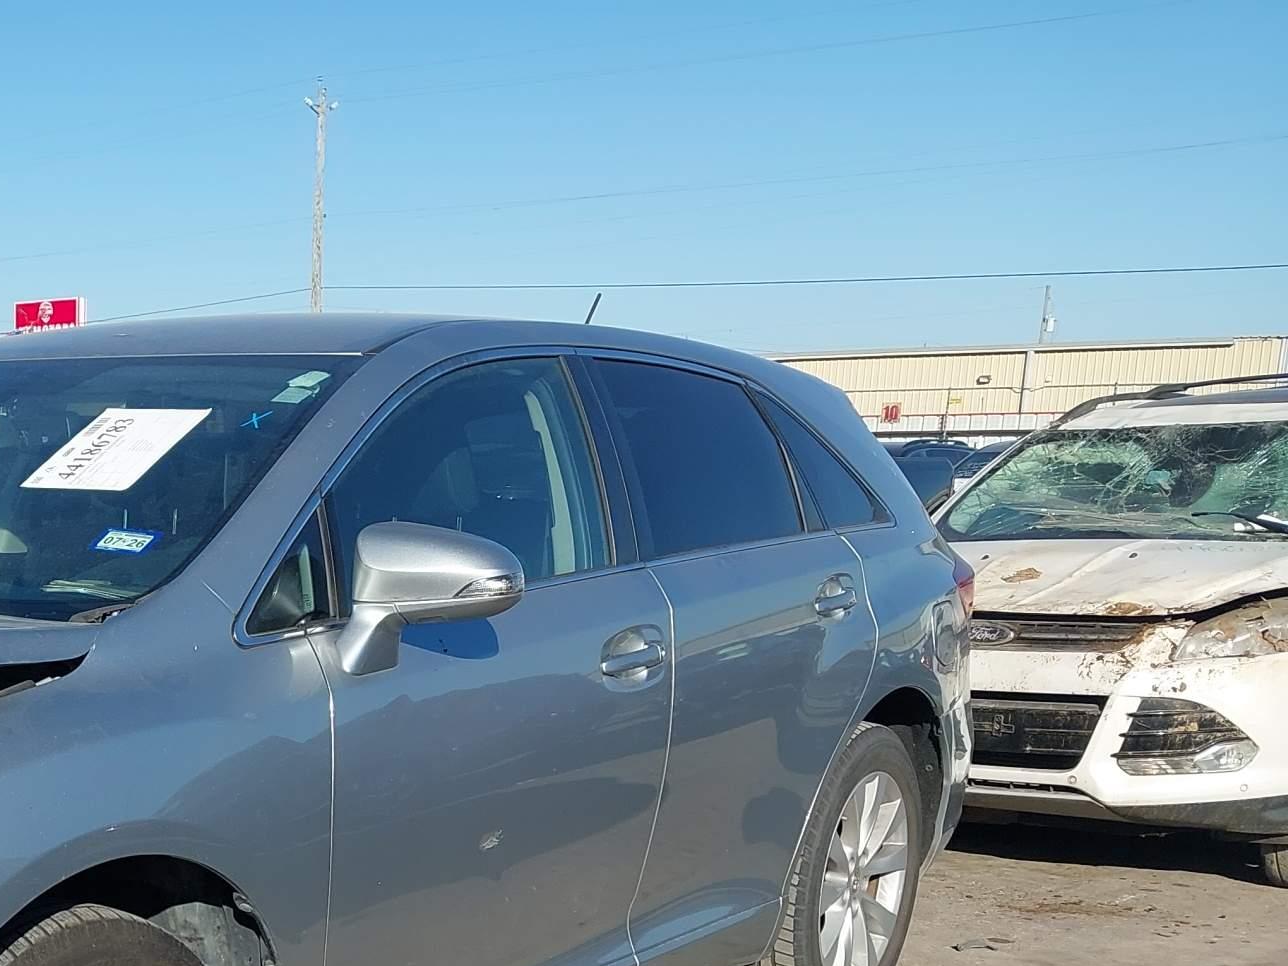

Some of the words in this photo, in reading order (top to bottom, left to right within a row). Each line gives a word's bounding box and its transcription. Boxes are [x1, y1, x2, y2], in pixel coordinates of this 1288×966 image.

[882, 404, 900, 421] 10
[58, 418, 135, 480] 44186783
[103, 536, 123, 546] 07
[125, 538, 147, 548] 26
[969, 626, 1000, 641] Ford
